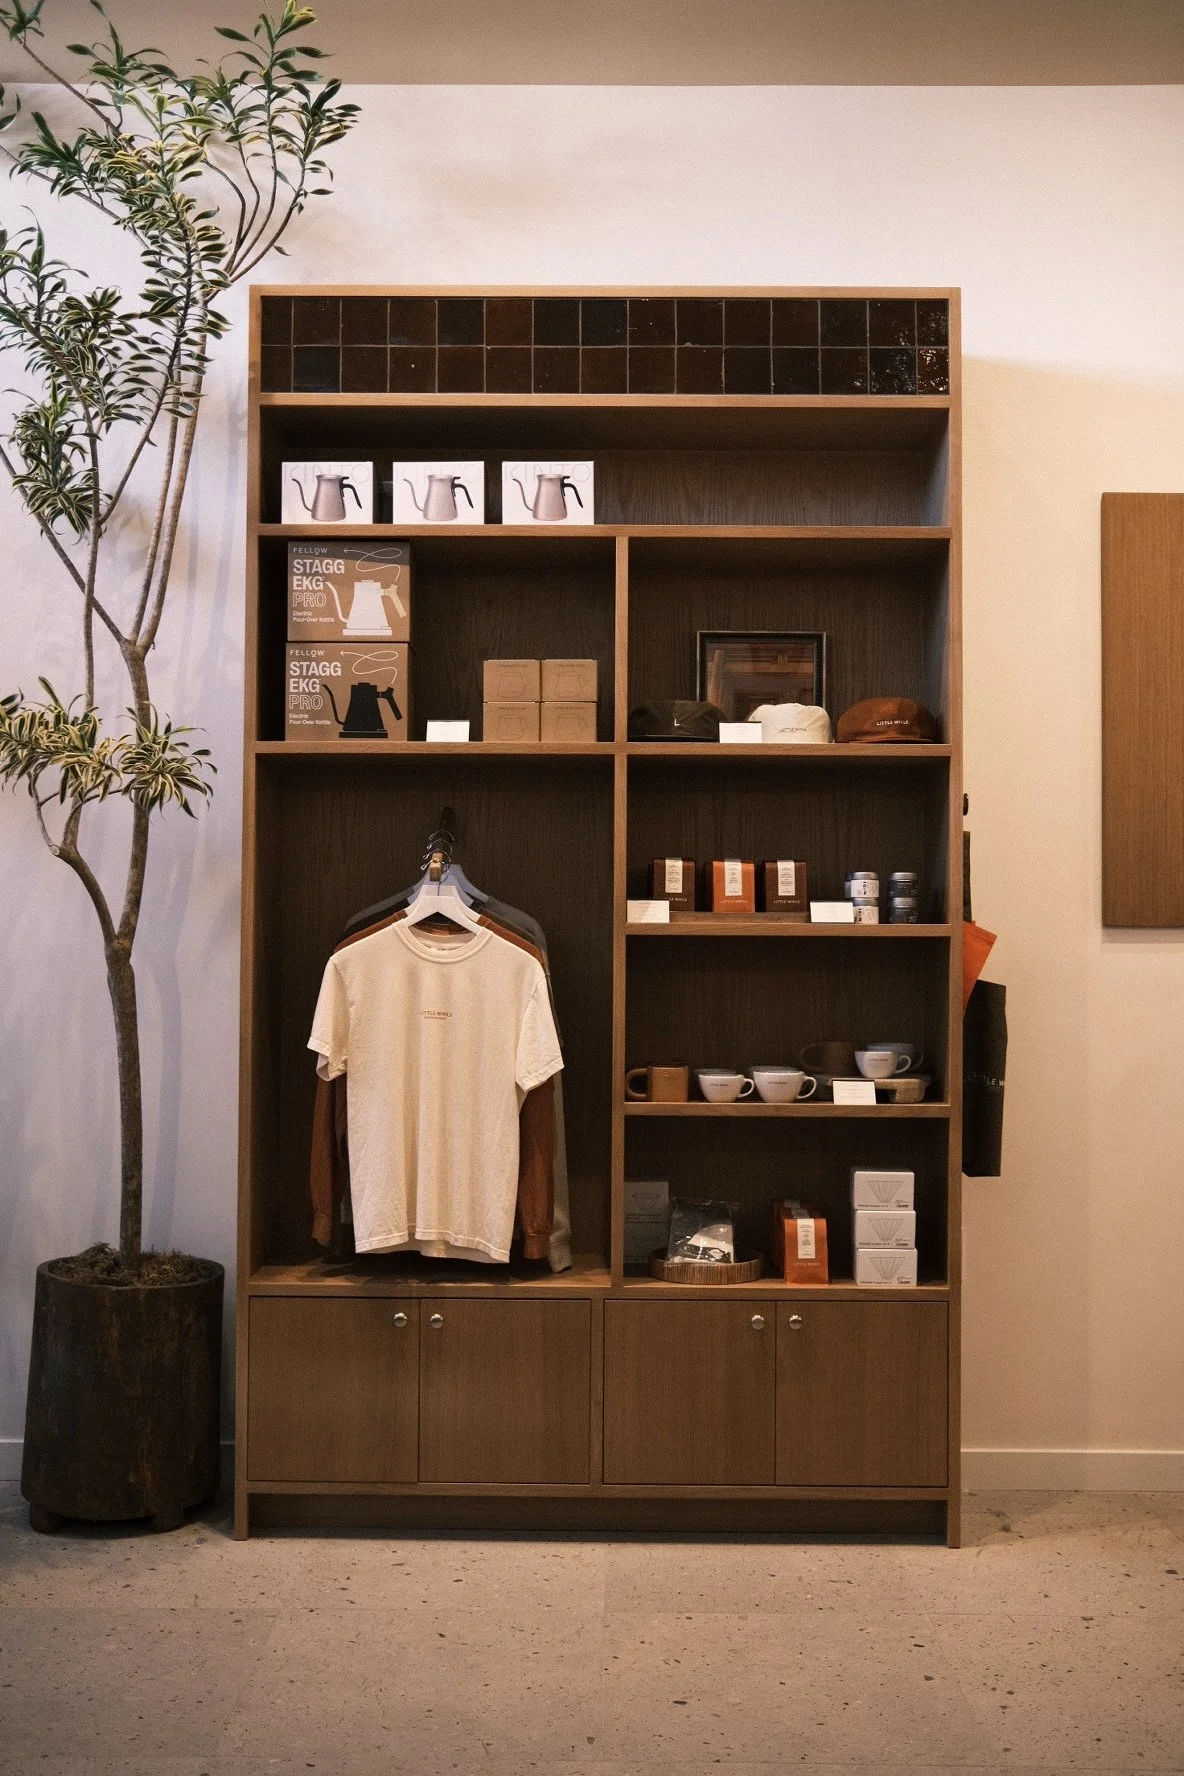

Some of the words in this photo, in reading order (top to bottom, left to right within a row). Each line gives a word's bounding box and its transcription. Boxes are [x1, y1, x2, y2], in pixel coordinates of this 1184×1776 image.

[293, 547, 328, 556] FELLOW
[293, 559, 345, 574] STAGG
[292, 592, 327, 608] PRO
[289, 649, 325, 658] FELLOW
[289, 661, 342, 676] STAGG
[288, 694, 324, 710] PRO
